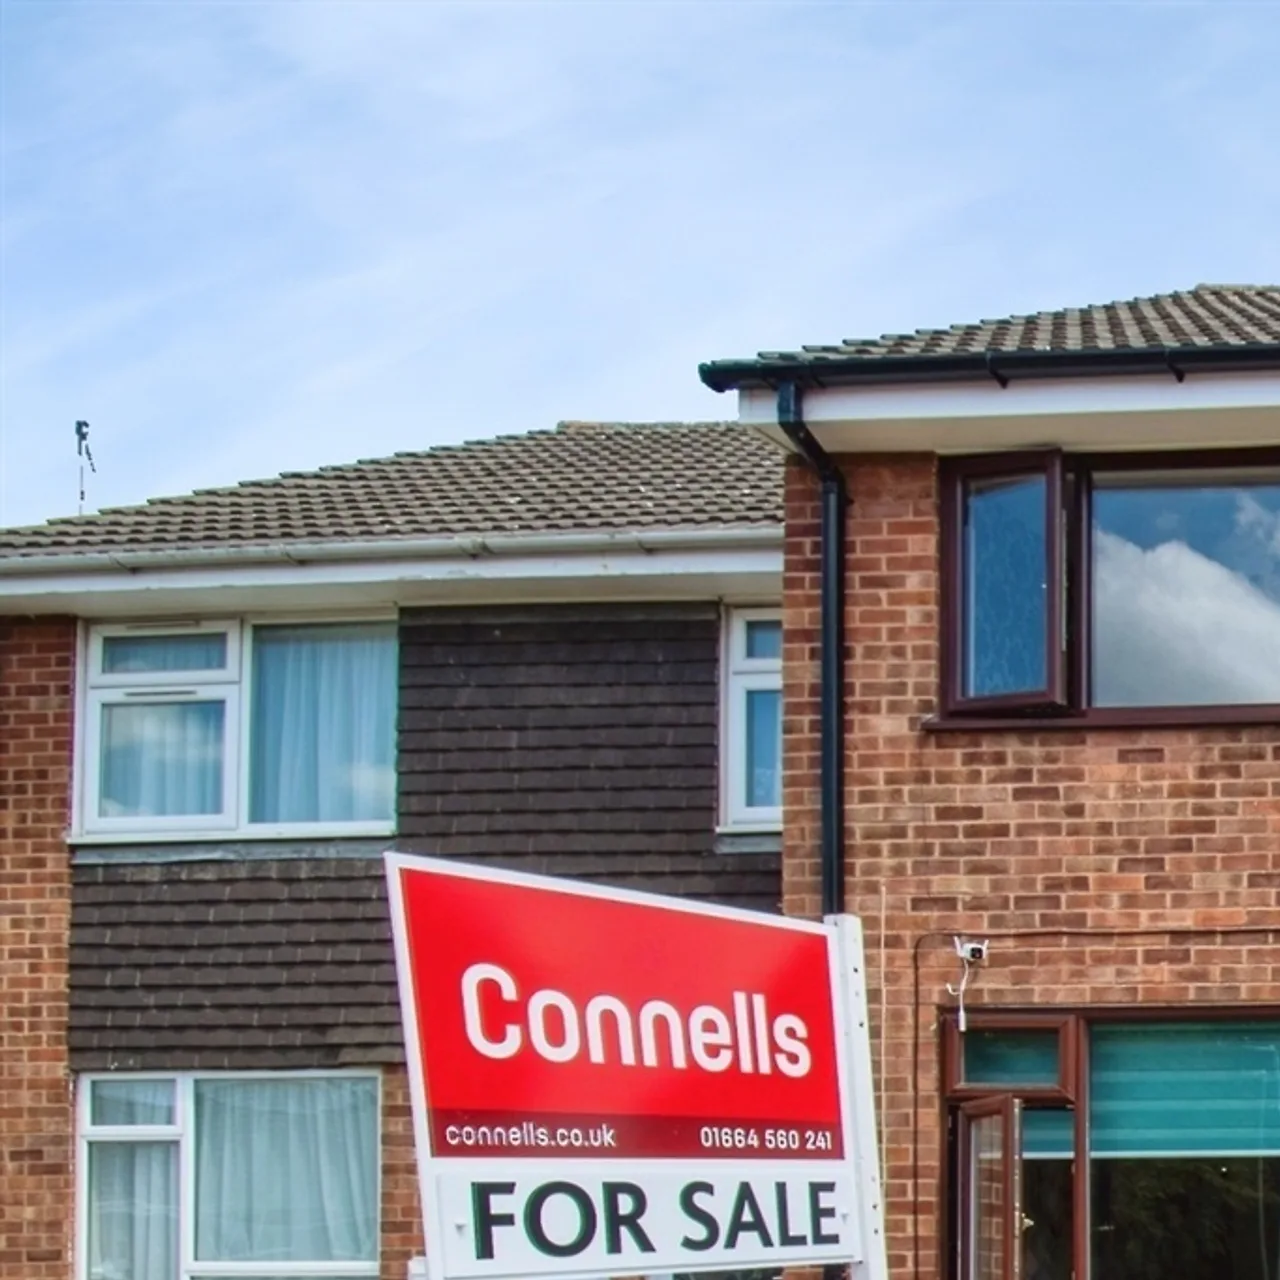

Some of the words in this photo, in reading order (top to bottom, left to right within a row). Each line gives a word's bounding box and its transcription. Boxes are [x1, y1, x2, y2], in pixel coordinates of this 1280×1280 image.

[460, 963, 812, 1078] Connells
[445, 1121, 616, 1148] connells.co.uk
[700, 1126, 759, 1149] 01664
[764, 1128, 799, 1150] 560
[804, 1130, 832, 1150] 241
[470, 1181, 655, 1260] FOR
[679, 1180, 841, 1252] SALE
